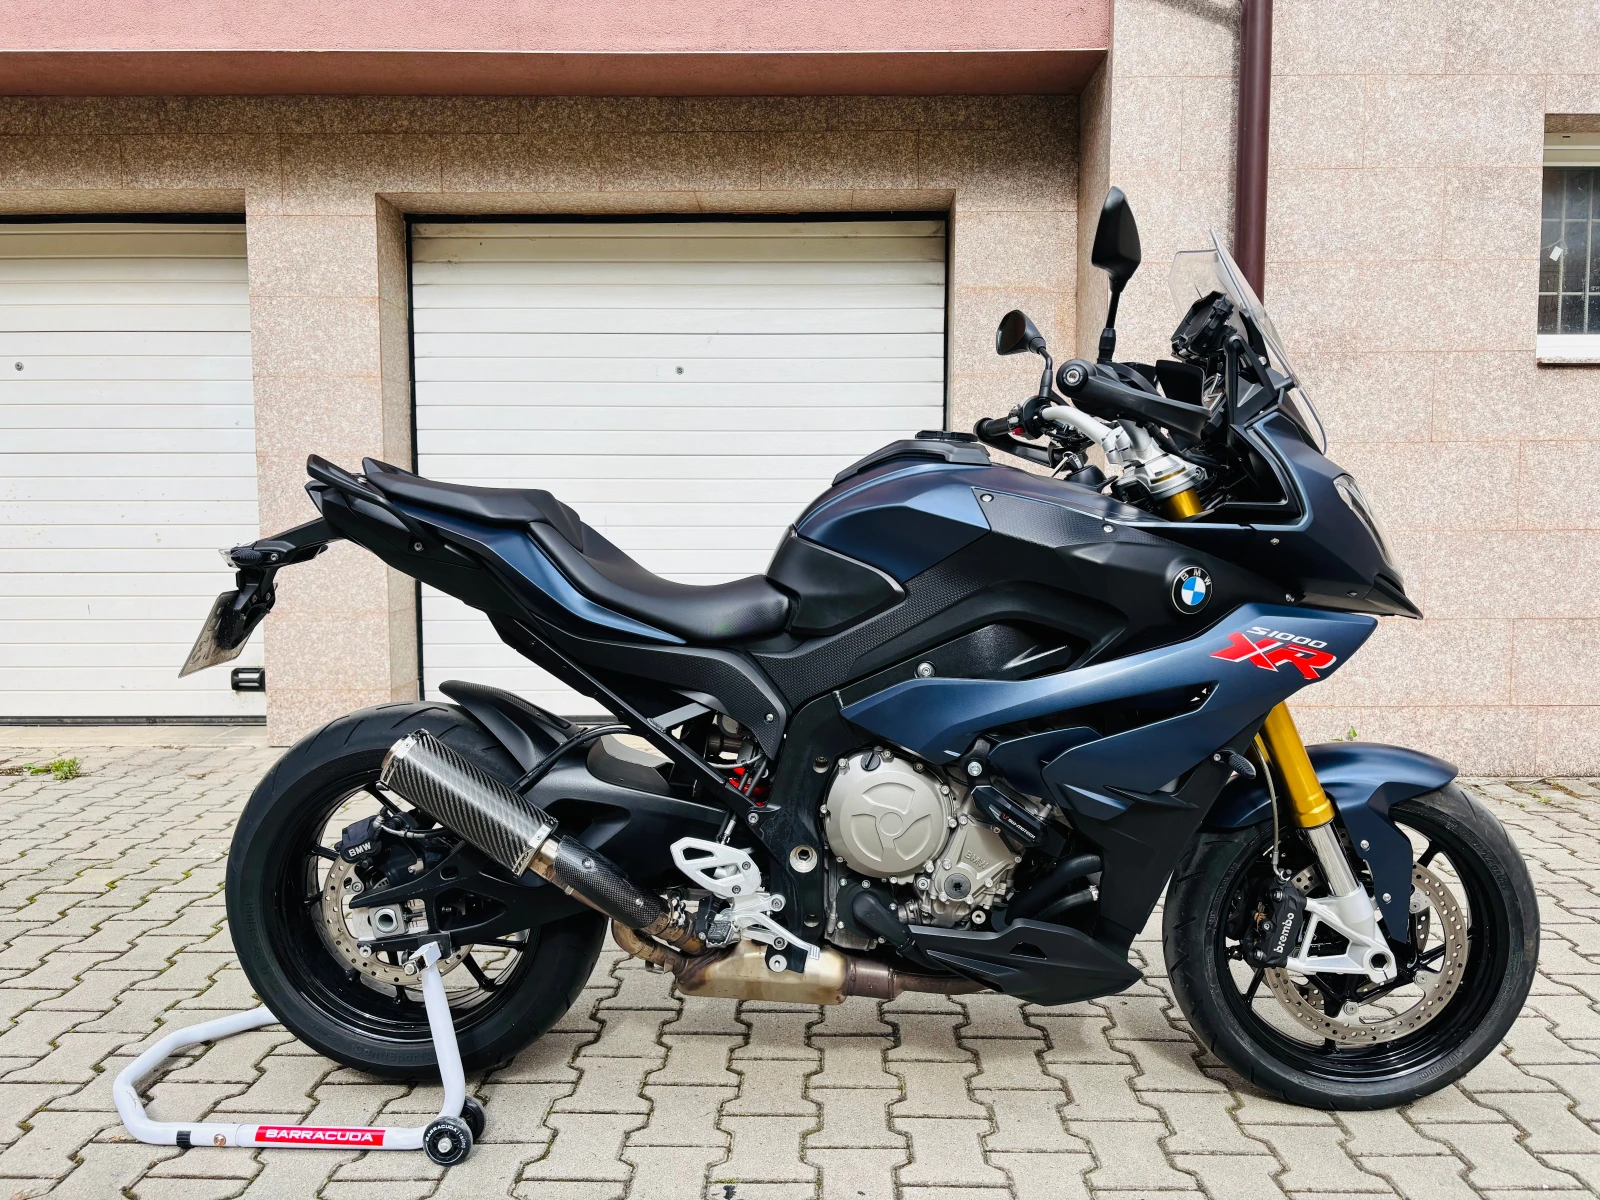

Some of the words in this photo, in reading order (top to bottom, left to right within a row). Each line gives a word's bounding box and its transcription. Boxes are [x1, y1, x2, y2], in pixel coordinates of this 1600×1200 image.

[1181, 568, 1211, 587] BMW
[1210, 631, 1337, 681] XR
[348, 842, 371, 858] BMW
[964, 850, 989, 869] BMW
[1273, 912, 1295, 954] brembo
[265, 1129, 374, 1142] BARRACUDA
[425, 1124, 457, 1142] BARRACUDA
